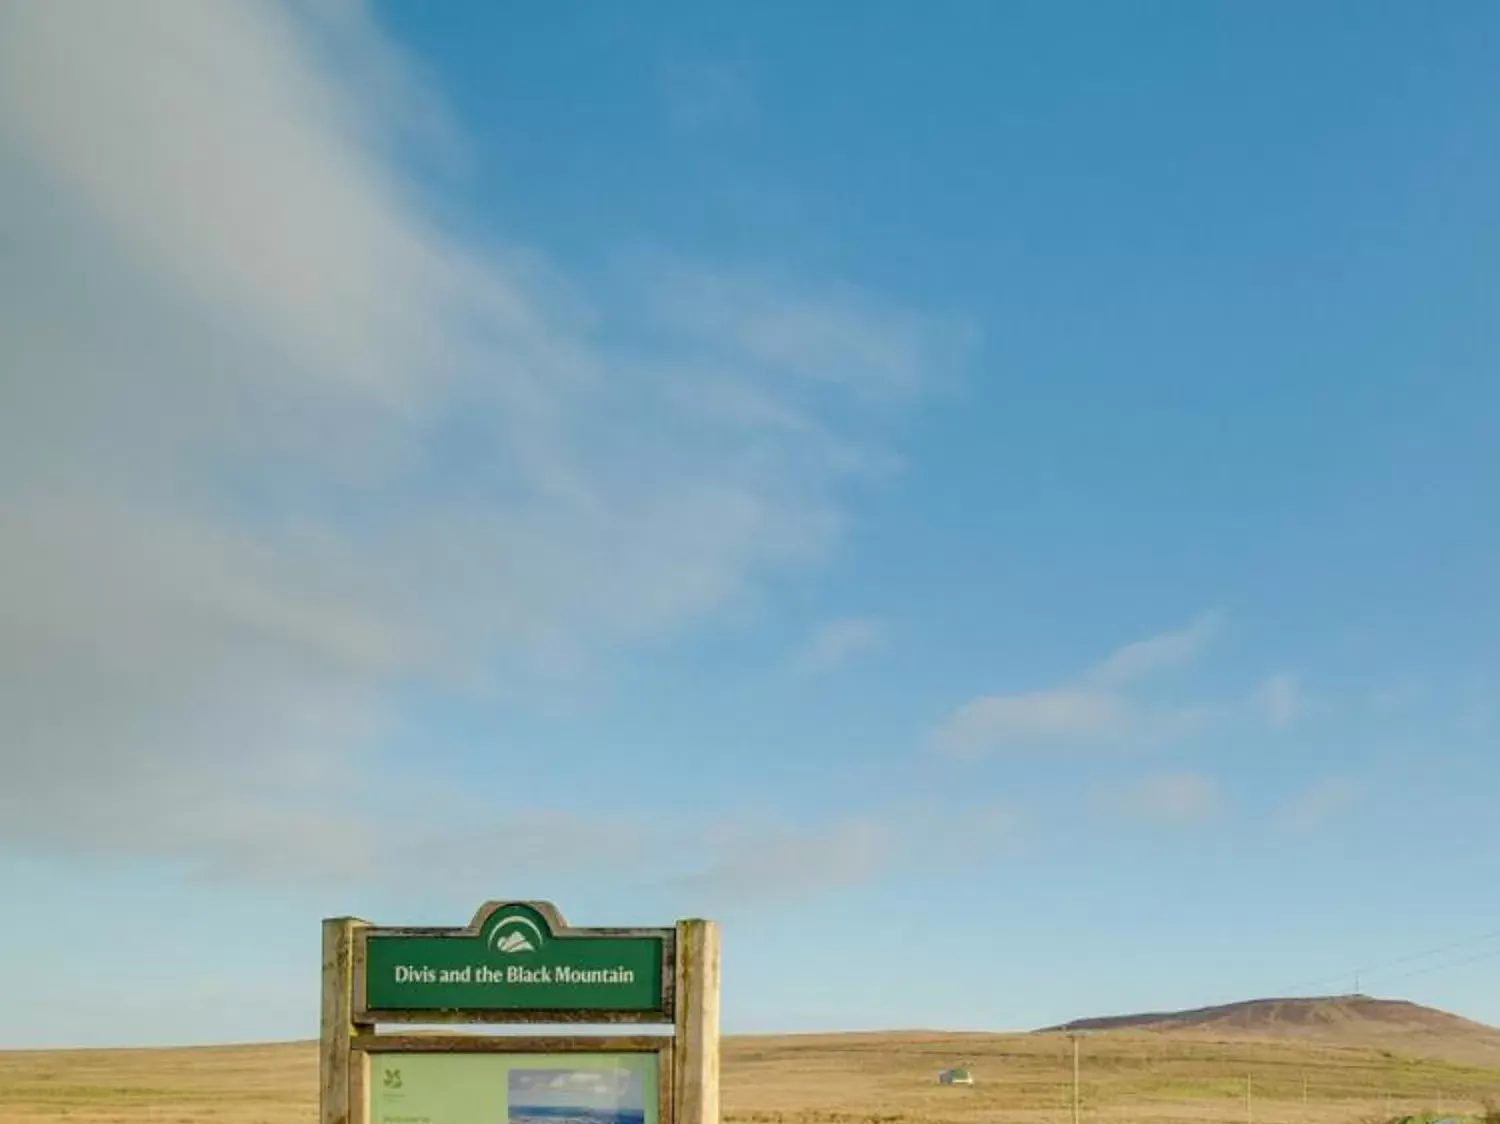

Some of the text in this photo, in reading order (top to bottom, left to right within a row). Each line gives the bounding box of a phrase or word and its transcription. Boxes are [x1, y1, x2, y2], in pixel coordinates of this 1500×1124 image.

[395, 964, 635, 983] Divis and the Black Mountain
